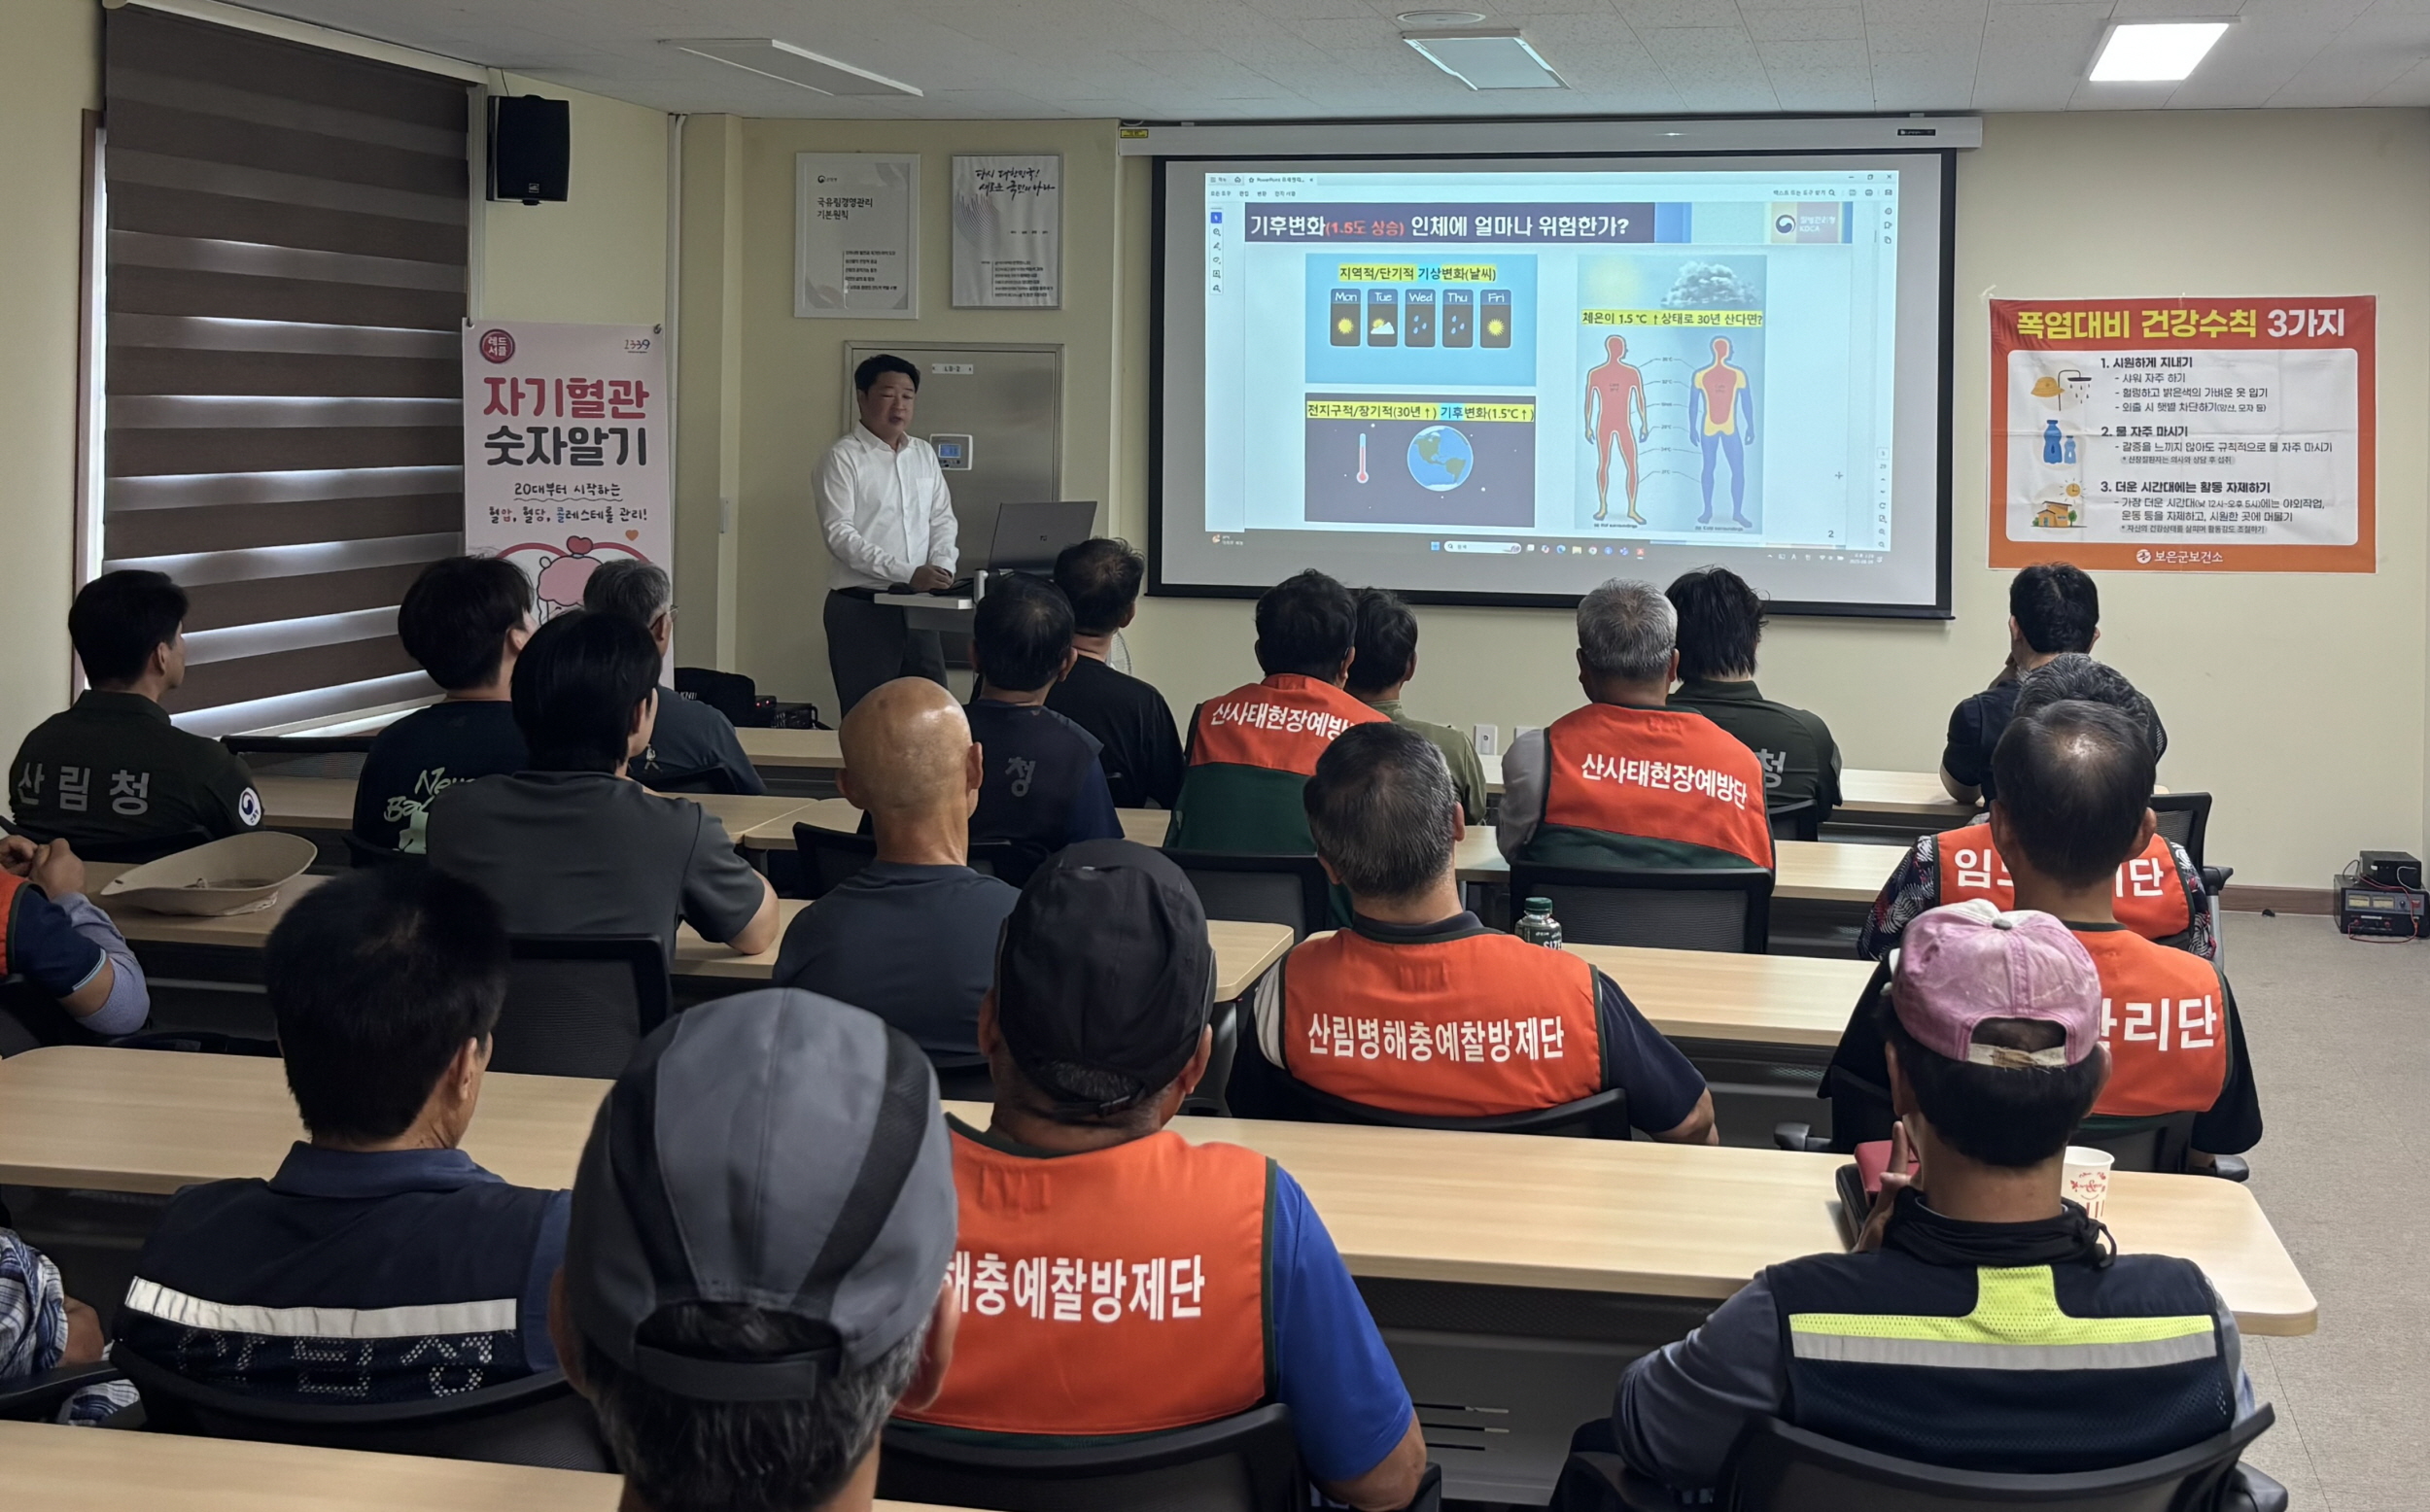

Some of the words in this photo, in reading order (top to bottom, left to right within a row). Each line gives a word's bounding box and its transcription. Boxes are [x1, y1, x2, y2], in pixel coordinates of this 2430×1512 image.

[1371, 220, 1406, 237] 상승)
[1410, 215, 1468, 237] 인체에
[1474, 215, 1533, 237] 얼마나
[1538, 215, 1630, 238] 위험한가?
[1338, 266, 1415, 282] 지역적/단기적
[1418, 266, 1497, 283] 기상변화(날씨)
[1335, 292, 1358, 302] Mon
[1374, 292, 1393, 302] Tue
[1408, 292, 1434, 303] Wed
[1447, 292, 1469, 304] Thu
[1487, 292, 1506, 304] Fri
[1618, 313, 1634, 325] 1.5
[1661, 312, 1694, 326] 상태로
[1697, 313, 1721, 326] 30년
[1724, 313, 1764, 326] 산다면?
[2017, 310, 2130, 340] 폭염대비
[2141, 309, 2257, 338] 건강수칙
[2267, 308, 2344, 338] 3가지
[487, 336, 507, 346] 레드
[2100, 358, 2110, 368] 1.
[2112, 357, 2158, 368] 시원하게
[2160, 357, 2193, 368] 지내기
[2122, 373, 2142, 383] 샤워
[2144, 373, 2165, 383] 자주
[2168, 372, 2186, 383] 하기
[483, 376, 650, 419] 자기혈관
[2122, 388, 2160, 398] 헐렁하고
[2163, 388, 2202, 398] 밝은색의
[2204, 388, 2234, 398] 가벼운
[2249, 388, 2268, 398] 입기
[2122, 402, 2142, 412] 외출
[2144, 402, 2155, 412] 시
[2100, 426, 2113, 437] 2.
[2116, 426, 2127, 437] 물
[2131, 426, 2153, 437] 자주
[2156, 426, 2188, 437] 마시기
[484, 425, 647, 466] 숫자알기
[2122, 441, 2152, 453] 갈증을
[2154, 441, 2183, 453] 느끼지
[2185, 441, 2215, 453] 않아도
[2218, 441, 2267, 453] 규칙적으로
[2281, 441, 2302, 453] 자주
[2304, 441, 2333, 453] 마시기
[514, 482, 568, 498] 20대부터
[573, 482, 621, 498] 시작하는
[2100, 481, 2112, 493] 3.
[2115, 481, 2137, 493] 더운
[2140, 481, 2197, 494] 시간대에는
[2200, 481, 2223, 494] 활동
[2226, 481, 2271, 494] 자제하기
[2121, 498, 2141, 508] 가장
[2144, 498, 2164, 508] 더운
[489, 506, 517, 524] 혈압,
[523, 506, 551, 524] 혈당,
[557, 506, 613, 524] 콜레스테롤
[619, 506, 648, 522] 관리!
[2121, 510, 2141, 522] 운동
[2144, 510, 2164, 522] 등을
[2166, 510, 2207, 523] 자제하고,
[2209, 511, 2239, 522] 시원한
[2240, 511, 2261, 523] 곳에
[2264, 511, 2293, 523] 머물기
[2154, 550, 2224, 564] 보은군보건소
[1004, 756, 1036, 798] 청
[1581, 752, 1748, 810] 산사태현장예방단
[17, 761, 150, 816] 산림청
[1307, 1013, 1565, 1063] 산림병해충예찰방제단
